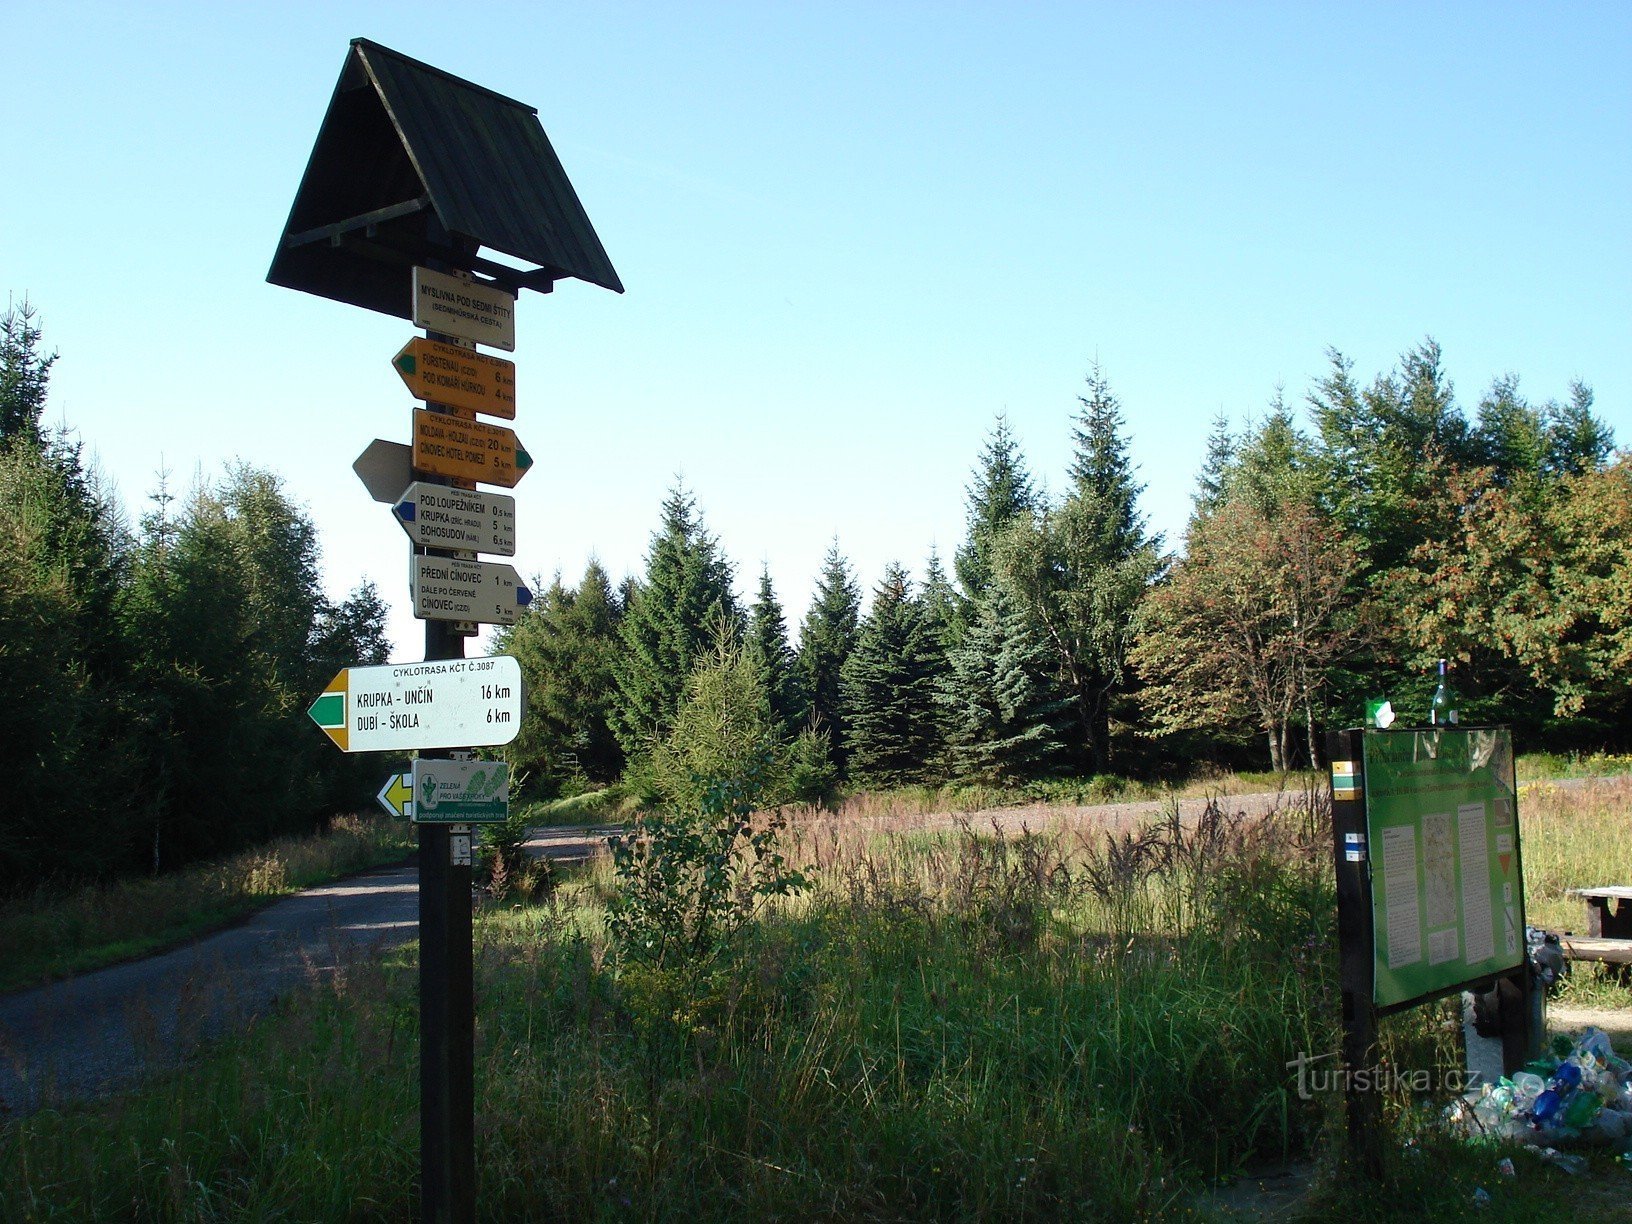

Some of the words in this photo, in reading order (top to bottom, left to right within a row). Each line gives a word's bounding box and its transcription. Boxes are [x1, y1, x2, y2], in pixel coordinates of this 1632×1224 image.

[421, 284, 455, 303] MYSLIVNA
[457, 295, 471, 307] POD
[493, 303, 510, 318] ŠTÍTY
[480, 316, 503, 329] CESTA)
[433, 343, 474, 360] CYKLOTRASA
[423, 371, 435, 384] POD
[495, 389, 501, 398] 4
[502, 392, 513, 401] km
[495, 371, 500, 382] 6
[503, 377, 513, 385] km
[430, 415, 472, 429] CYKLOTRASA
[420, 424, 444, 439] MOLDAVA
[488, 439, 498, 450] 20
[501, 444, 511, 452] km
[420, 440, 445, 457] CÍNOVEC
[446, 447, 464, 461] HOTEL
[494, 457, 499, 467] 5
[501, 461, 511, 469] km
[421, 495, 435, 506] POD
[437, 498, 485, 514] LOUPEŽNÍKEM
[493, 506, 503, 517] 0,5
[421, 510, 450, 523] KRUPKA
[464, 520, 481, 529] HRADU)
[493, 521, 498, 530] 5
[421, 525, 465, 540] BOHOSUDOV
[493, 535, 503, 545] 6,5
[421, 566, 449, 580] PŘEDNÍ
[450, 569, 482, 583] CÍNOVEC
[495, 576, 499, 585] 1
[421, 585, 437, 594] DÁLE
[449, 586, 476, 598] ČERVENÉ
[422, 597, 453, 610] CÍNOVEC
[496, 605, 500, 614] 5
[393, 665, 447, 677] CYKLOTRASA
[449, 662, 465, 674] KČT
[468, 660, 494, 672] Č.3087
[357, 692, 393, 708] KRUPKA
[404, 685, 433, 704] UNČÍN
[481, 685, 492, 700] 16
[495, 684, 510, 699] km
[357, 712, 378, 731] DUBÍ
[390, 711, 419, 730] ŠKOLA
[486, 710, 492, 723] 6
[495, 709, 510, 723] km
